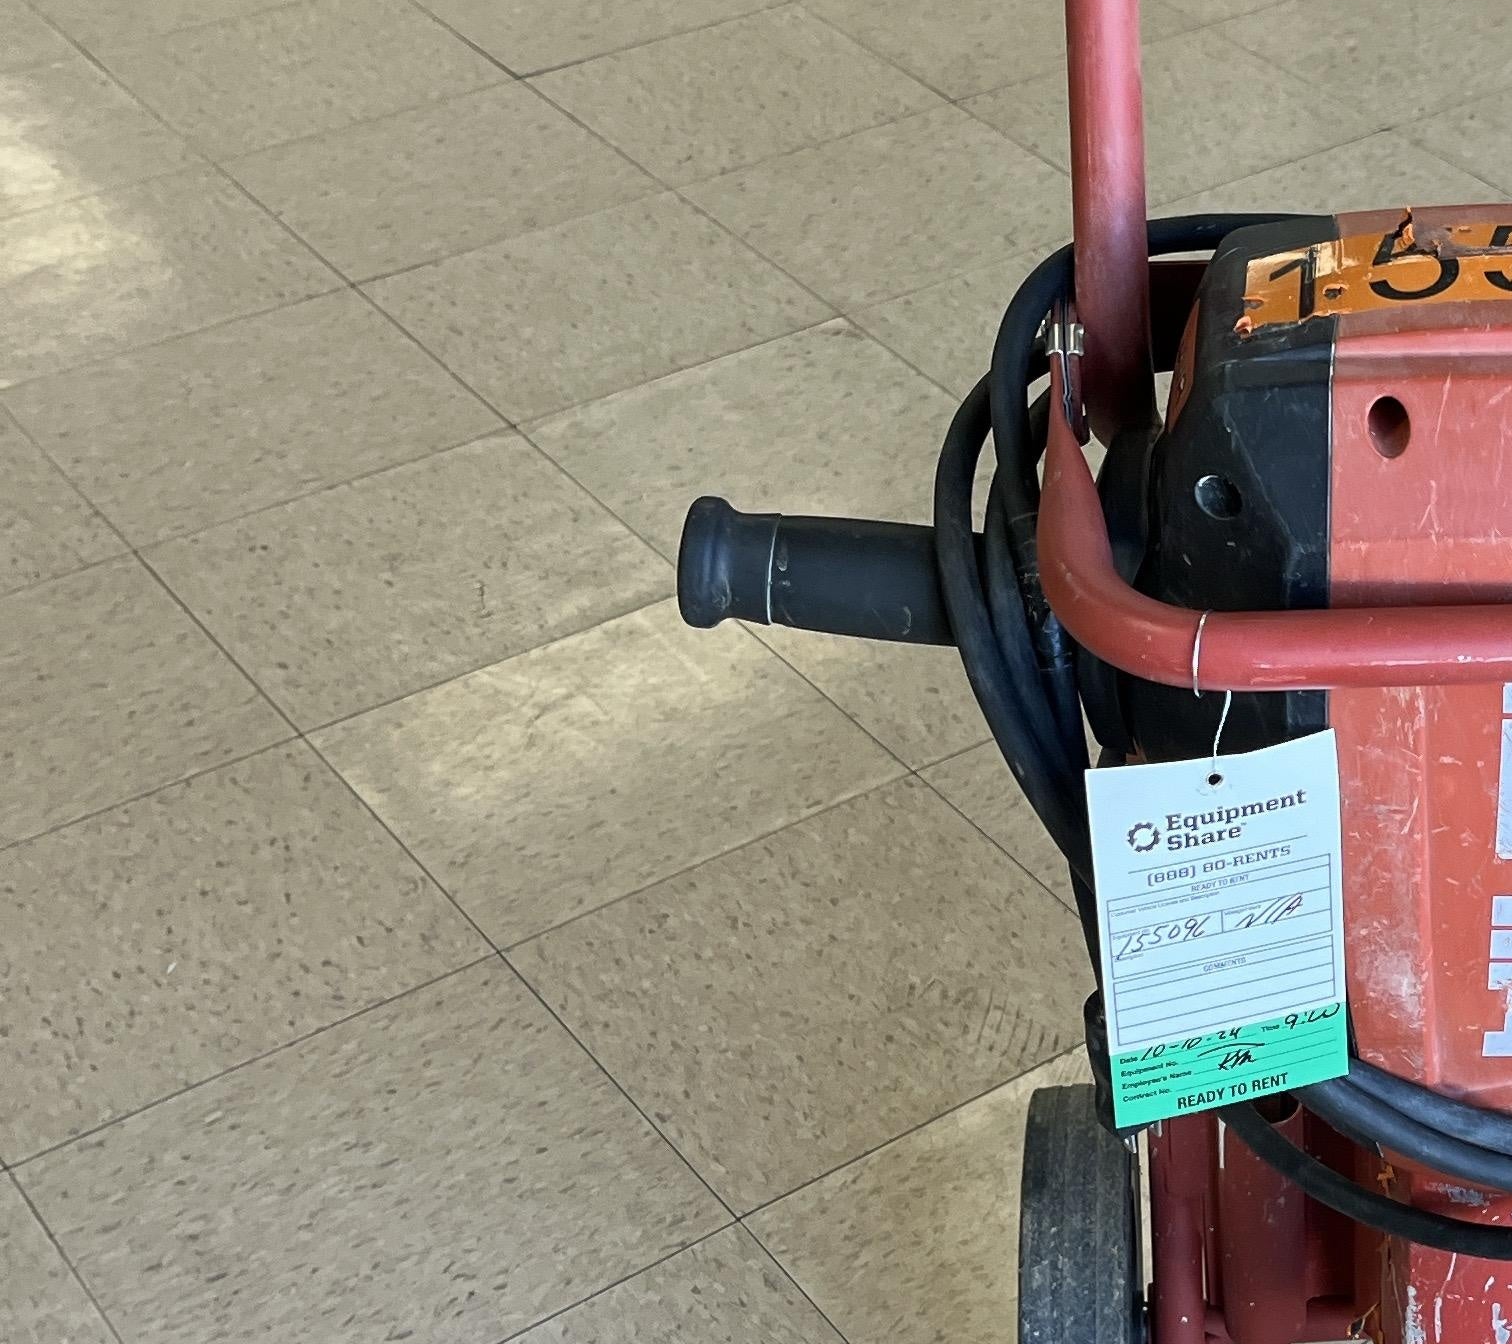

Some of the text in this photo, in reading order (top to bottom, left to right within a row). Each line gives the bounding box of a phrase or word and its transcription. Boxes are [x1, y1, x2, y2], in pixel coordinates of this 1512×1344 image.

[1165, 788, 1308, 832] Equipment
[1166, 825, 1242, 851] Share
[1147, 844, 1292, 887] (888) 80-RENTS
[1191, 873, 1249, 892] READY TO RENT
[1115, 915, 1211, 961] 155096
[1177, 1072, 1289, 1110] READY TO RENT
